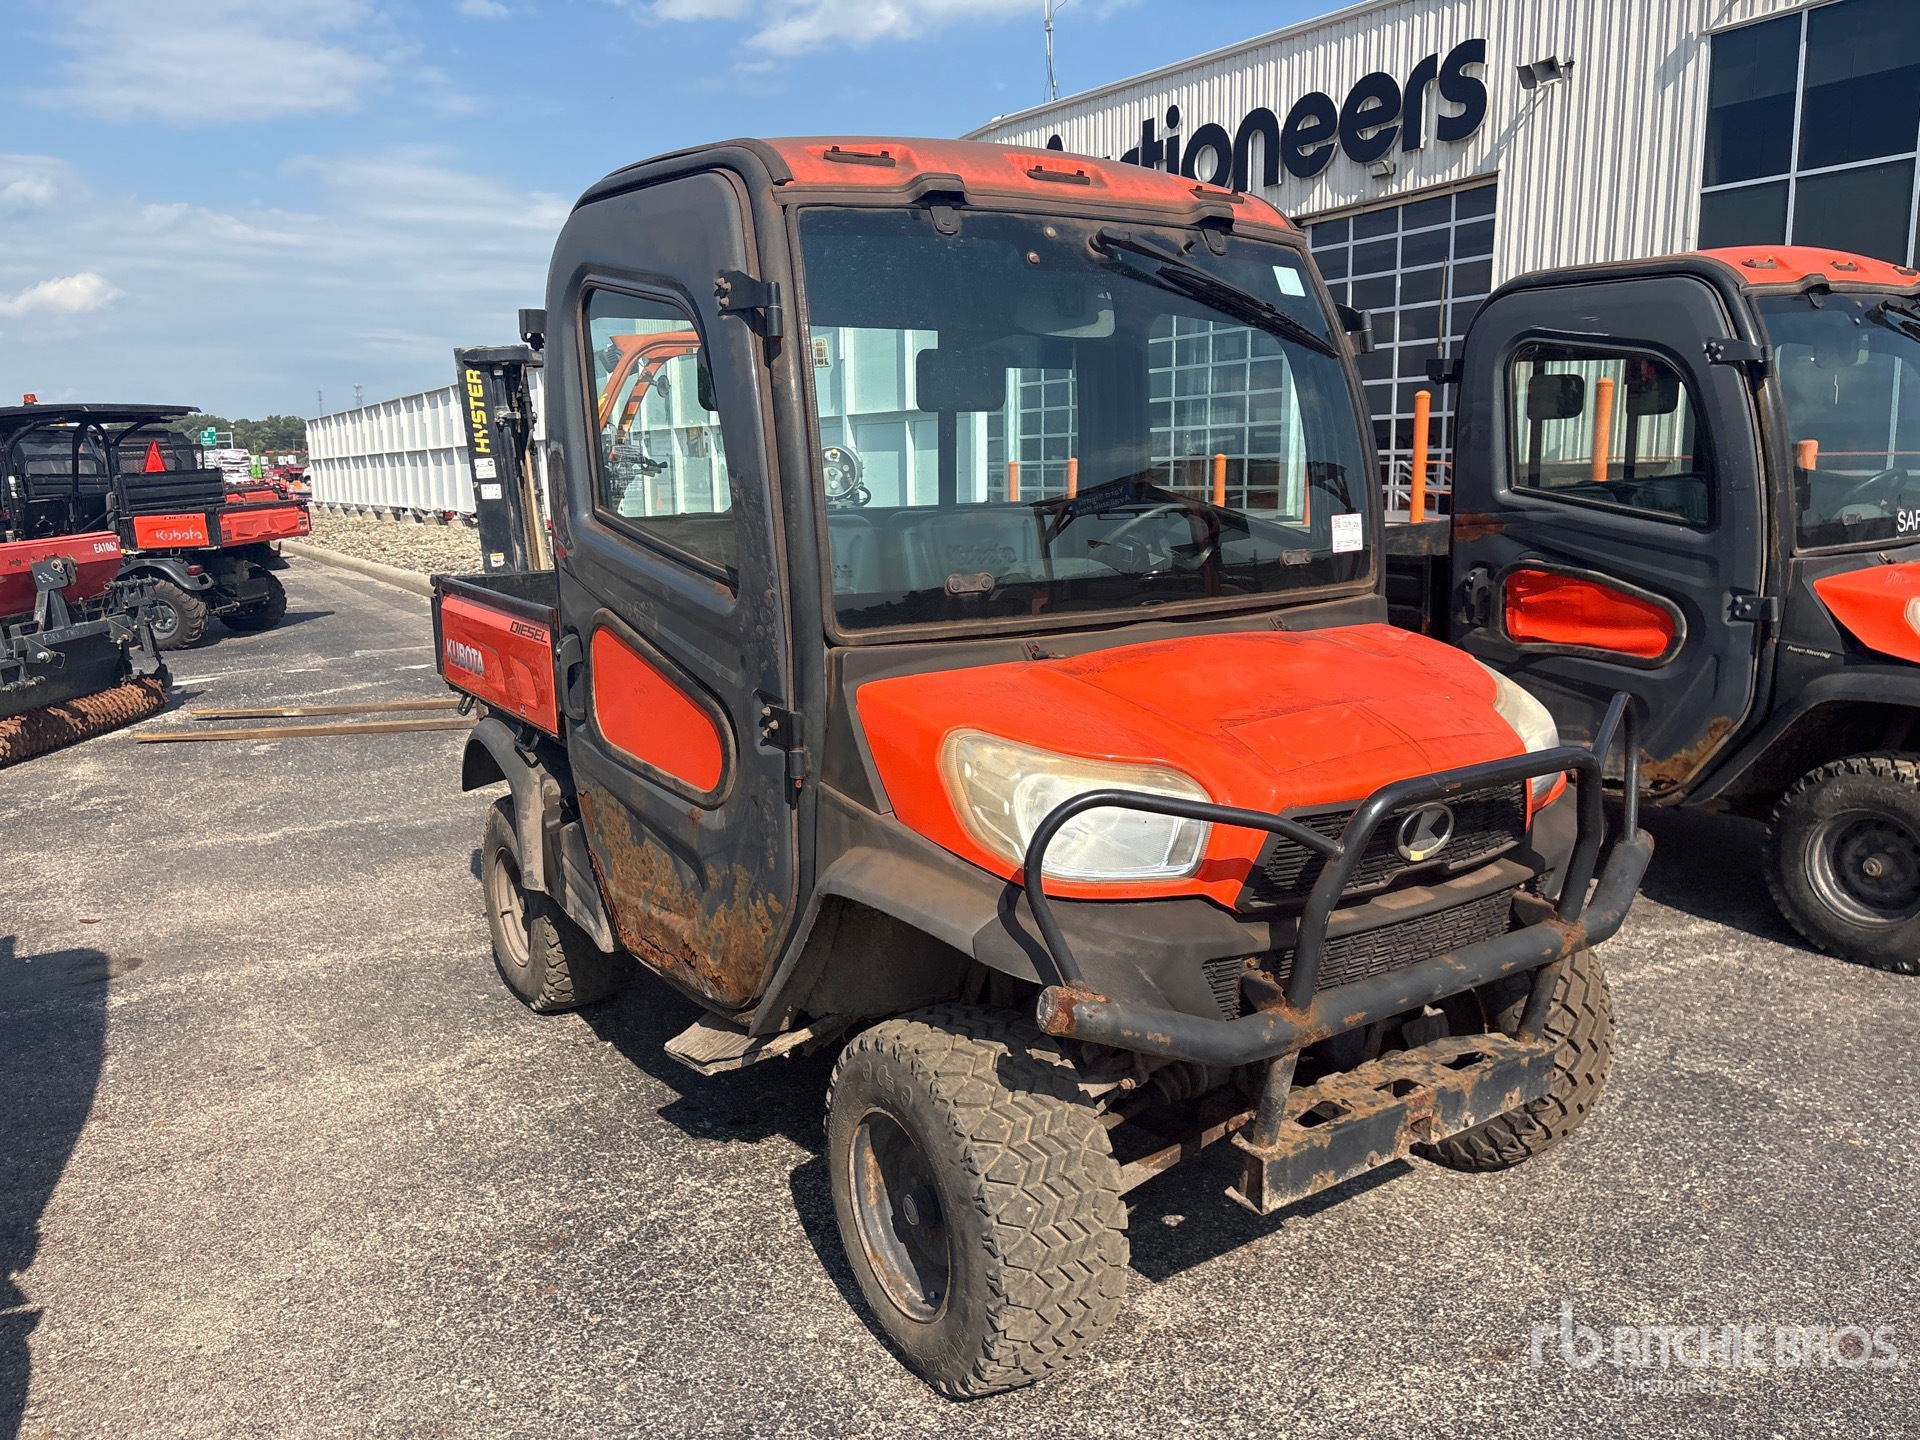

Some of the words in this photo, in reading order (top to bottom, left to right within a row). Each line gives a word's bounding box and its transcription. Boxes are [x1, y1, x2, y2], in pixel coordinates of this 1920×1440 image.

[1047, 38, 1487, 192] tioneers
[465, 368, 491, 454] HYSTER
[93, 541, 118, 554] EA1062
[156, 525, 203, 541] Kubota
[509, 620, 548, 644] DIESEL
[446, 637, 486, 677] KUBOTA
